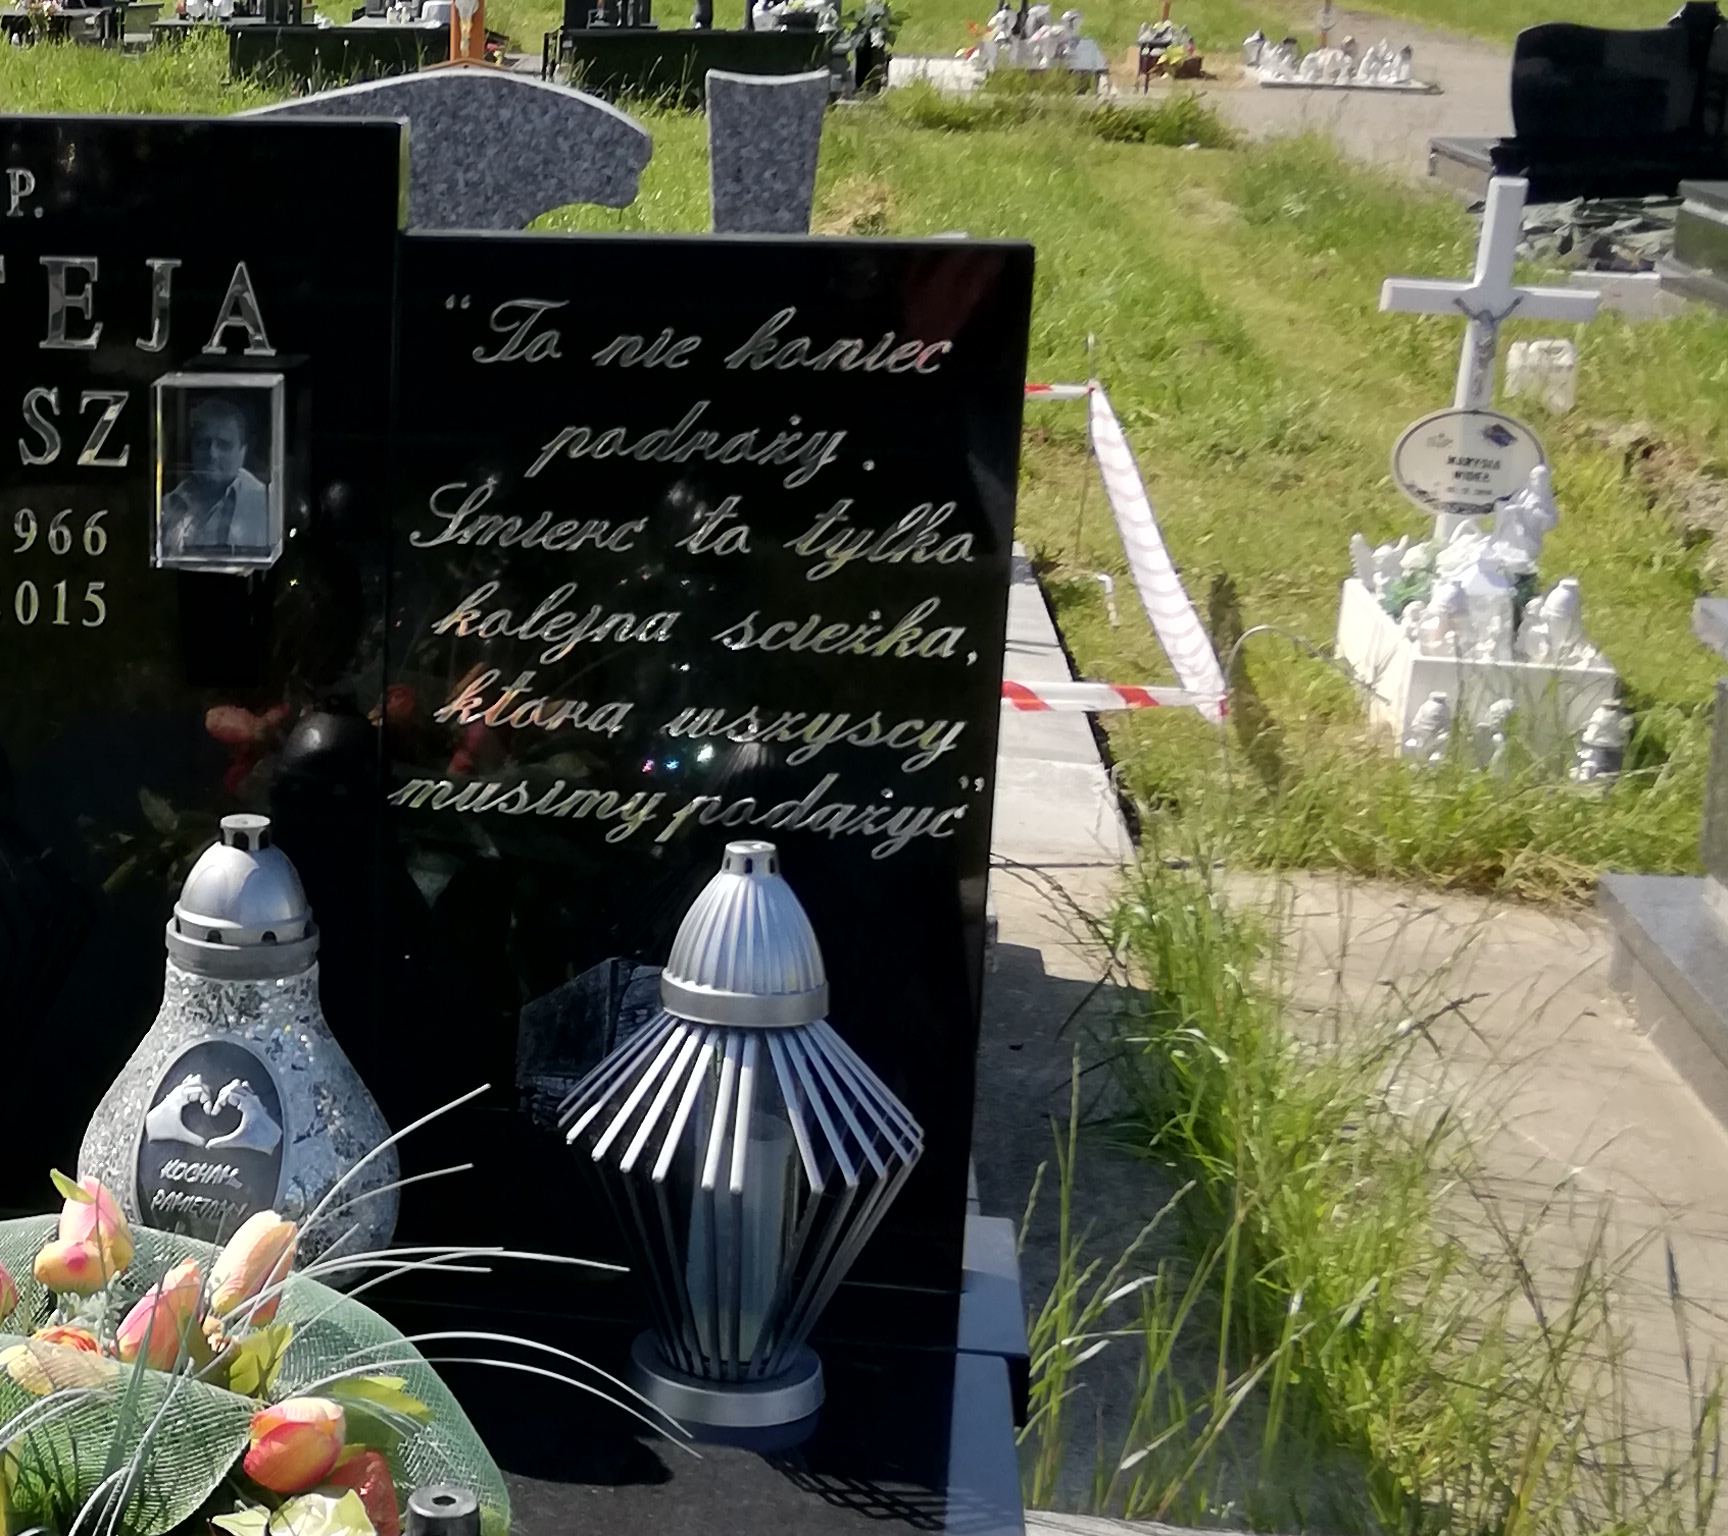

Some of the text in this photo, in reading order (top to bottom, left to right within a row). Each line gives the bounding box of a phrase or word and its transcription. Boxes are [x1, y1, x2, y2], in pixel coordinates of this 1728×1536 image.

[6, 167, 44, 219] P.
[592, 327, 702, 368] nie
[724, 306, 953, 374] koniec
[675, 495, 751, 556] to
[782, 498, 975, 581] tylko
[431, 580, 682, 664] kolejna
[661, 706, 967, 773] wszyscy
[387, 779, 667, 843] musimy
